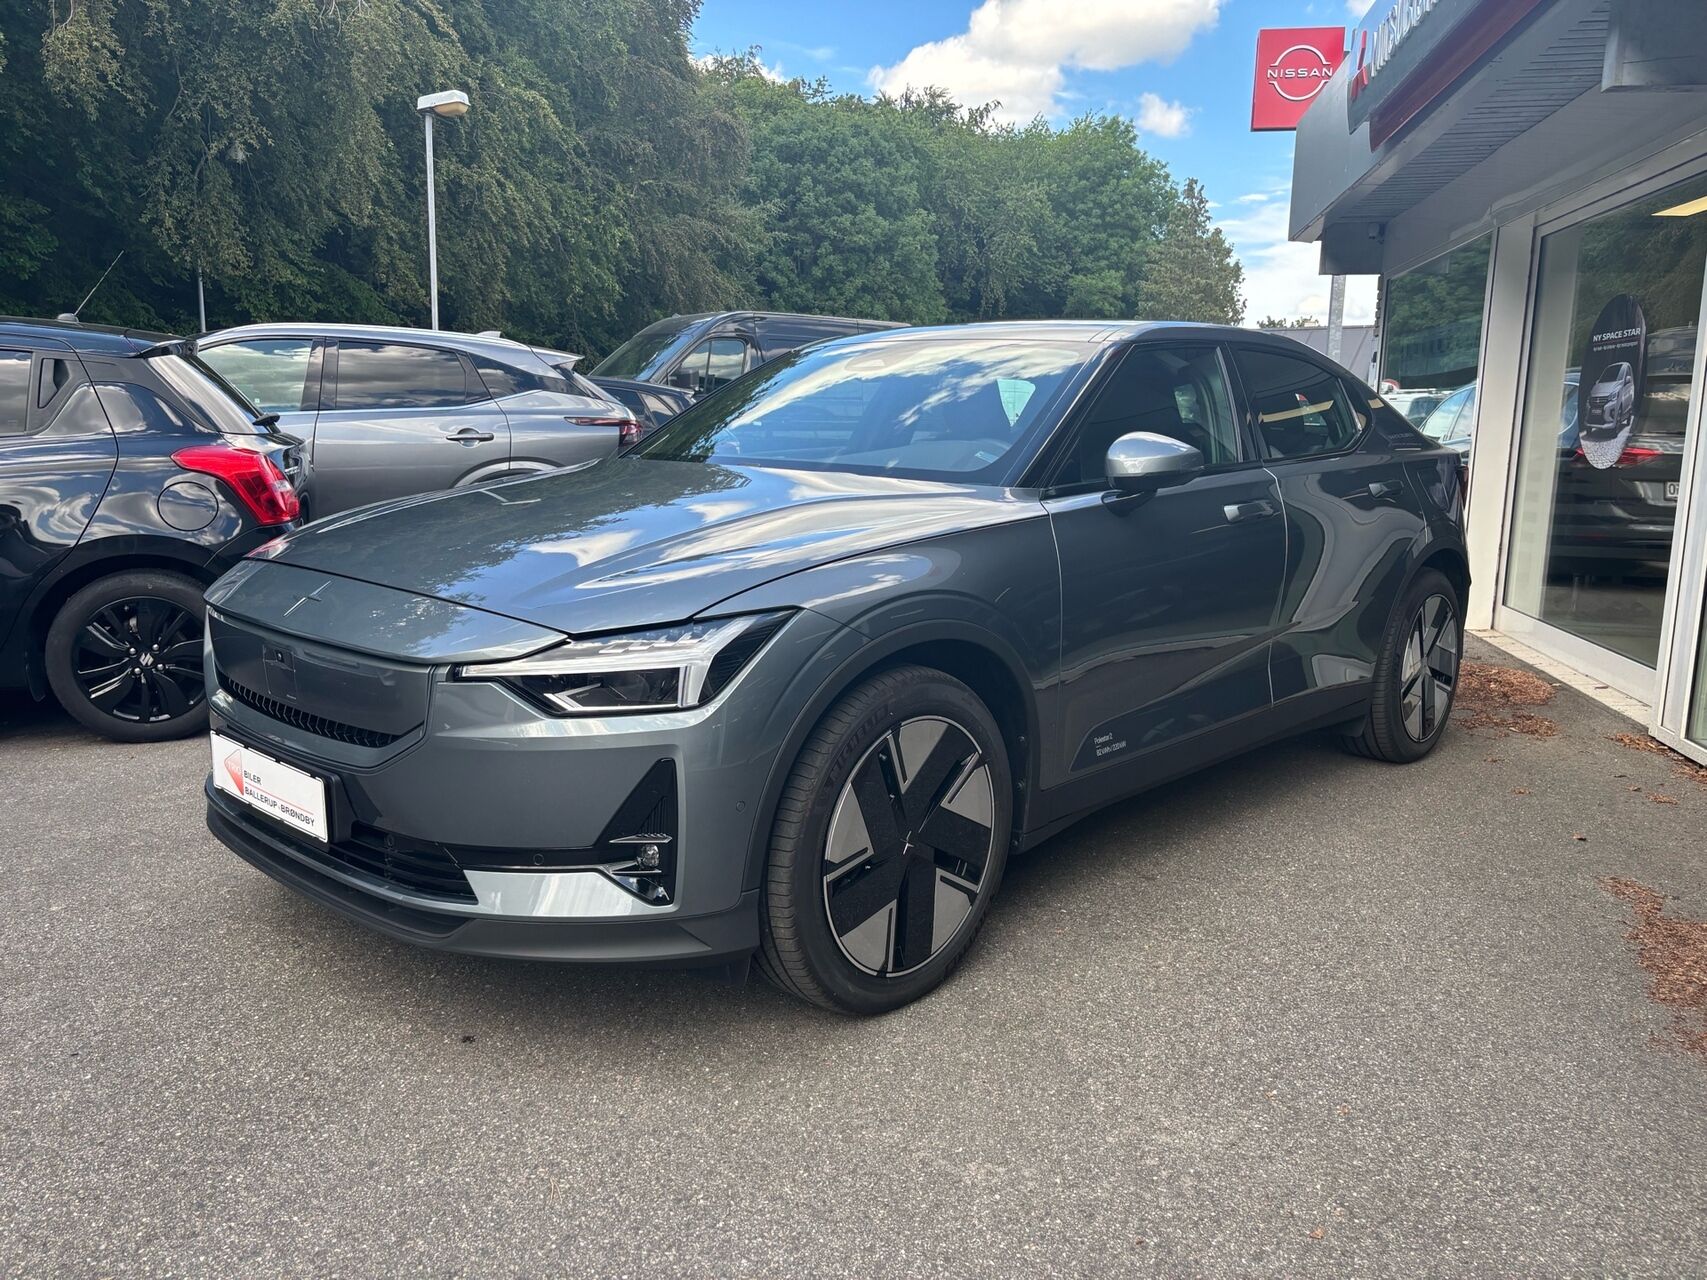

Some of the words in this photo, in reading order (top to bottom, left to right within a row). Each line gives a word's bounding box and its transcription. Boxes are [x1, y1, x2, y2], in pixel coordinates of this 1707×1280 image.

[1267, 67, 1333, 78] NISSAN
[1602, 330, 1623, 340] SPACE
[1623, 328, 1641, 337] STAR
[244, 770, 262, 785] BILER
[245, 786, 278, 808] BALLERUP
[280, 804, 315, 827] BRØNDBY
